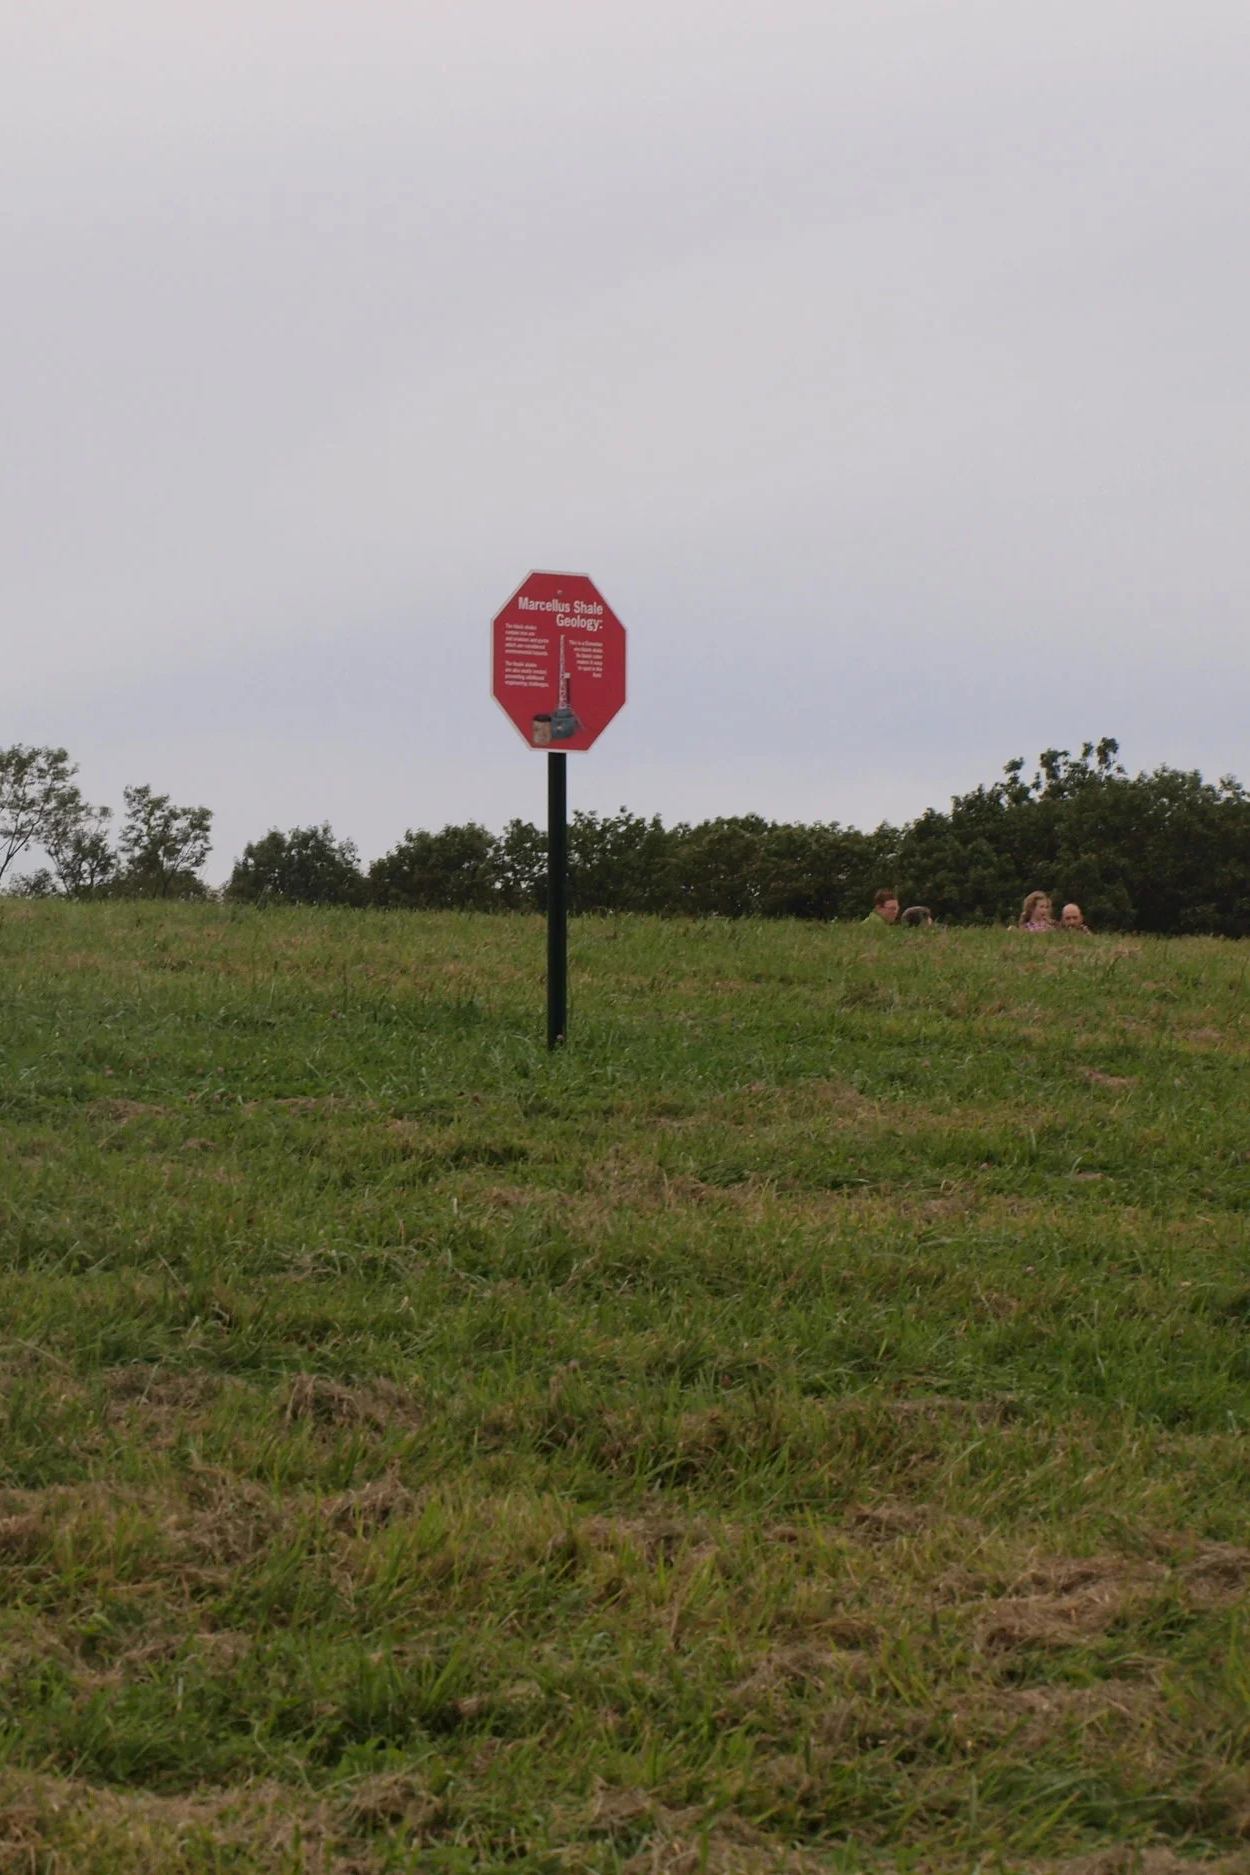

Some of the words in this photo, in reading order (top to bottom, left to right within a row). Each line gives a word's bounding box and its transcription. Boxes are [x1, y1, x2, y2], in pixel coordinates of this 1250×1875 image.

[518, 596, 570, 613] Marcellus
[573, 600, 603, 615] Shale
[556, 613, 603, 632] Geology:
